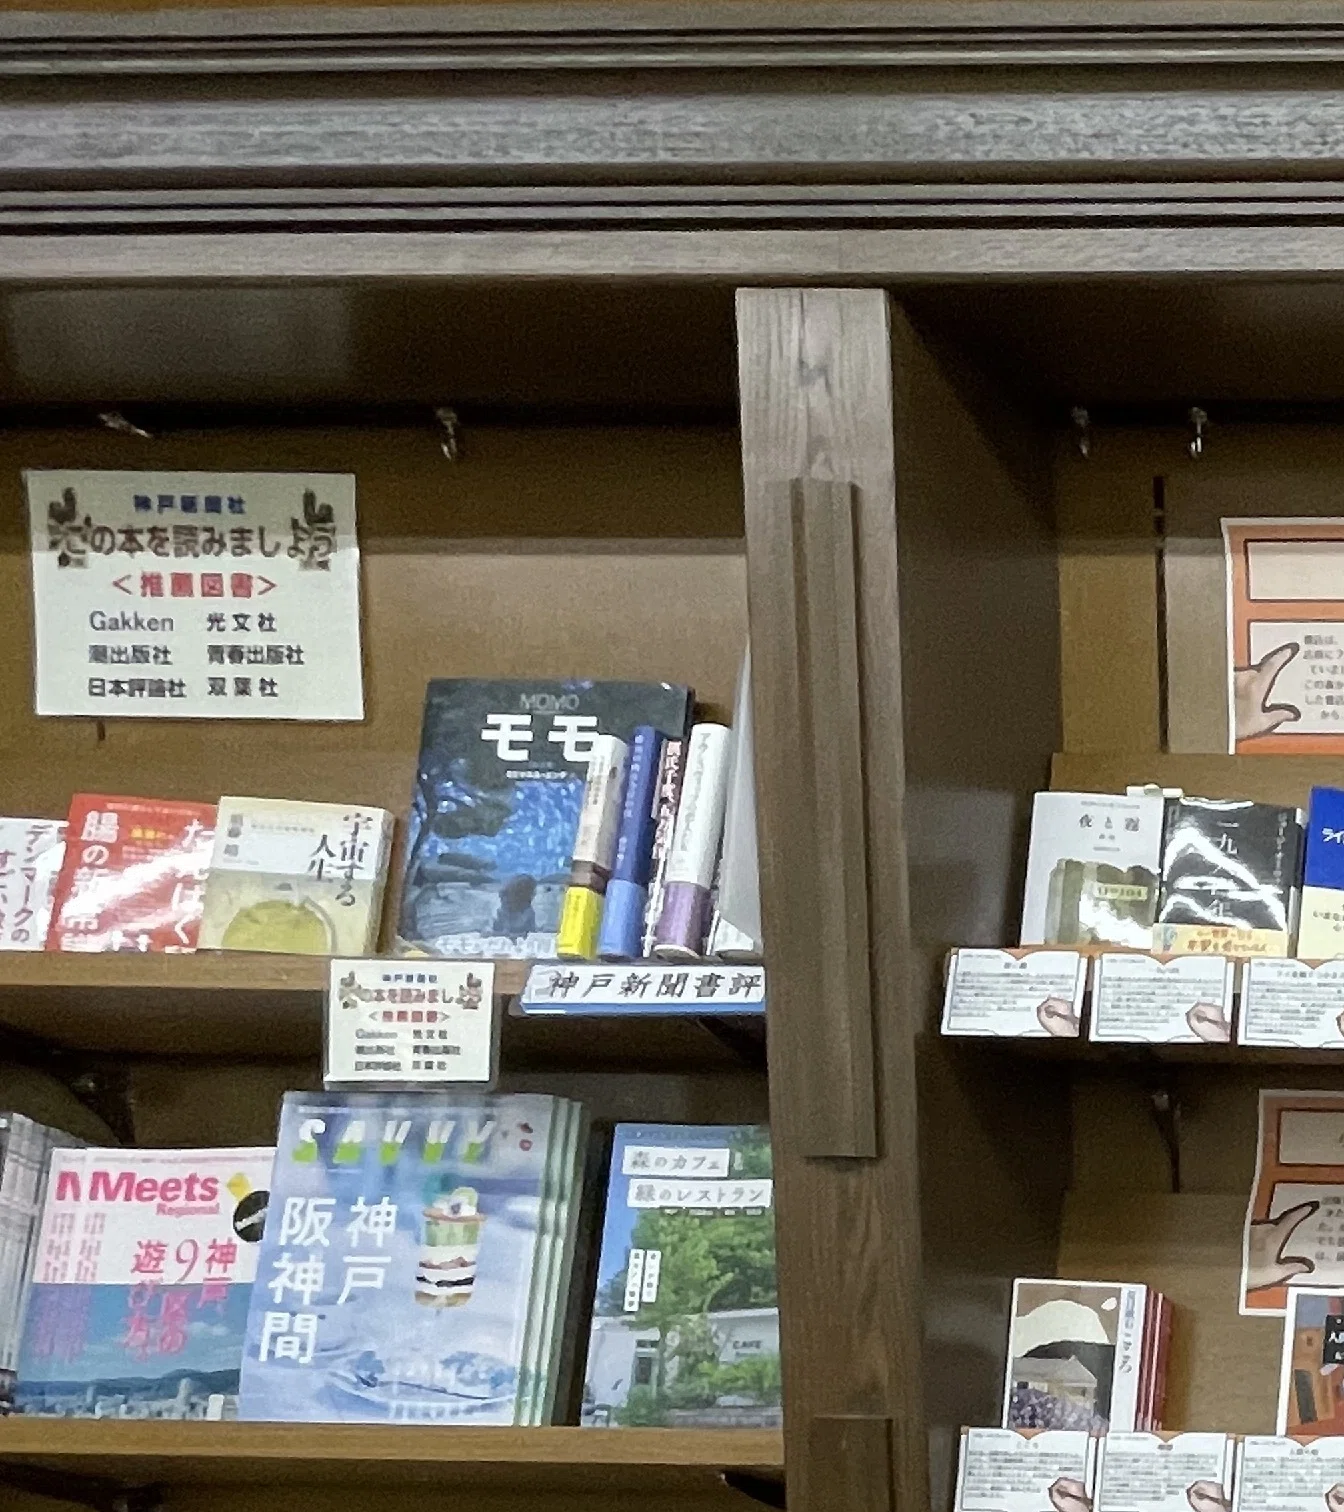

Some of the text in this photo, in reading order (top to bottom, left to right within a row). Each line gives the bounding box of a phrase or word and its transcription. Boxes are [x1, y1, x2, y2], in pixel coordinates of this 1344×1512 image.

[89, 611, 175, 633] Gakken
[206, 612, 277, 634] 光文社
[88, 677, 187, 699] 日本評論社
[207, 678, 279, 699] 双葉社
[519, 693, 580, 710] MOMO
[480, 712, 601, 763] モモ
[548, 971, 762, 999] 神戸新聞書評
[291, 1118, 500, 1164] SAVVY
[630, 1150, 722, 1171] 森のカフェ
[88, 1171, 220, 1203] Meets
[338, 1197, 398, 1305] 神戸
[258, 1197, 331, 1365] 阪神間
